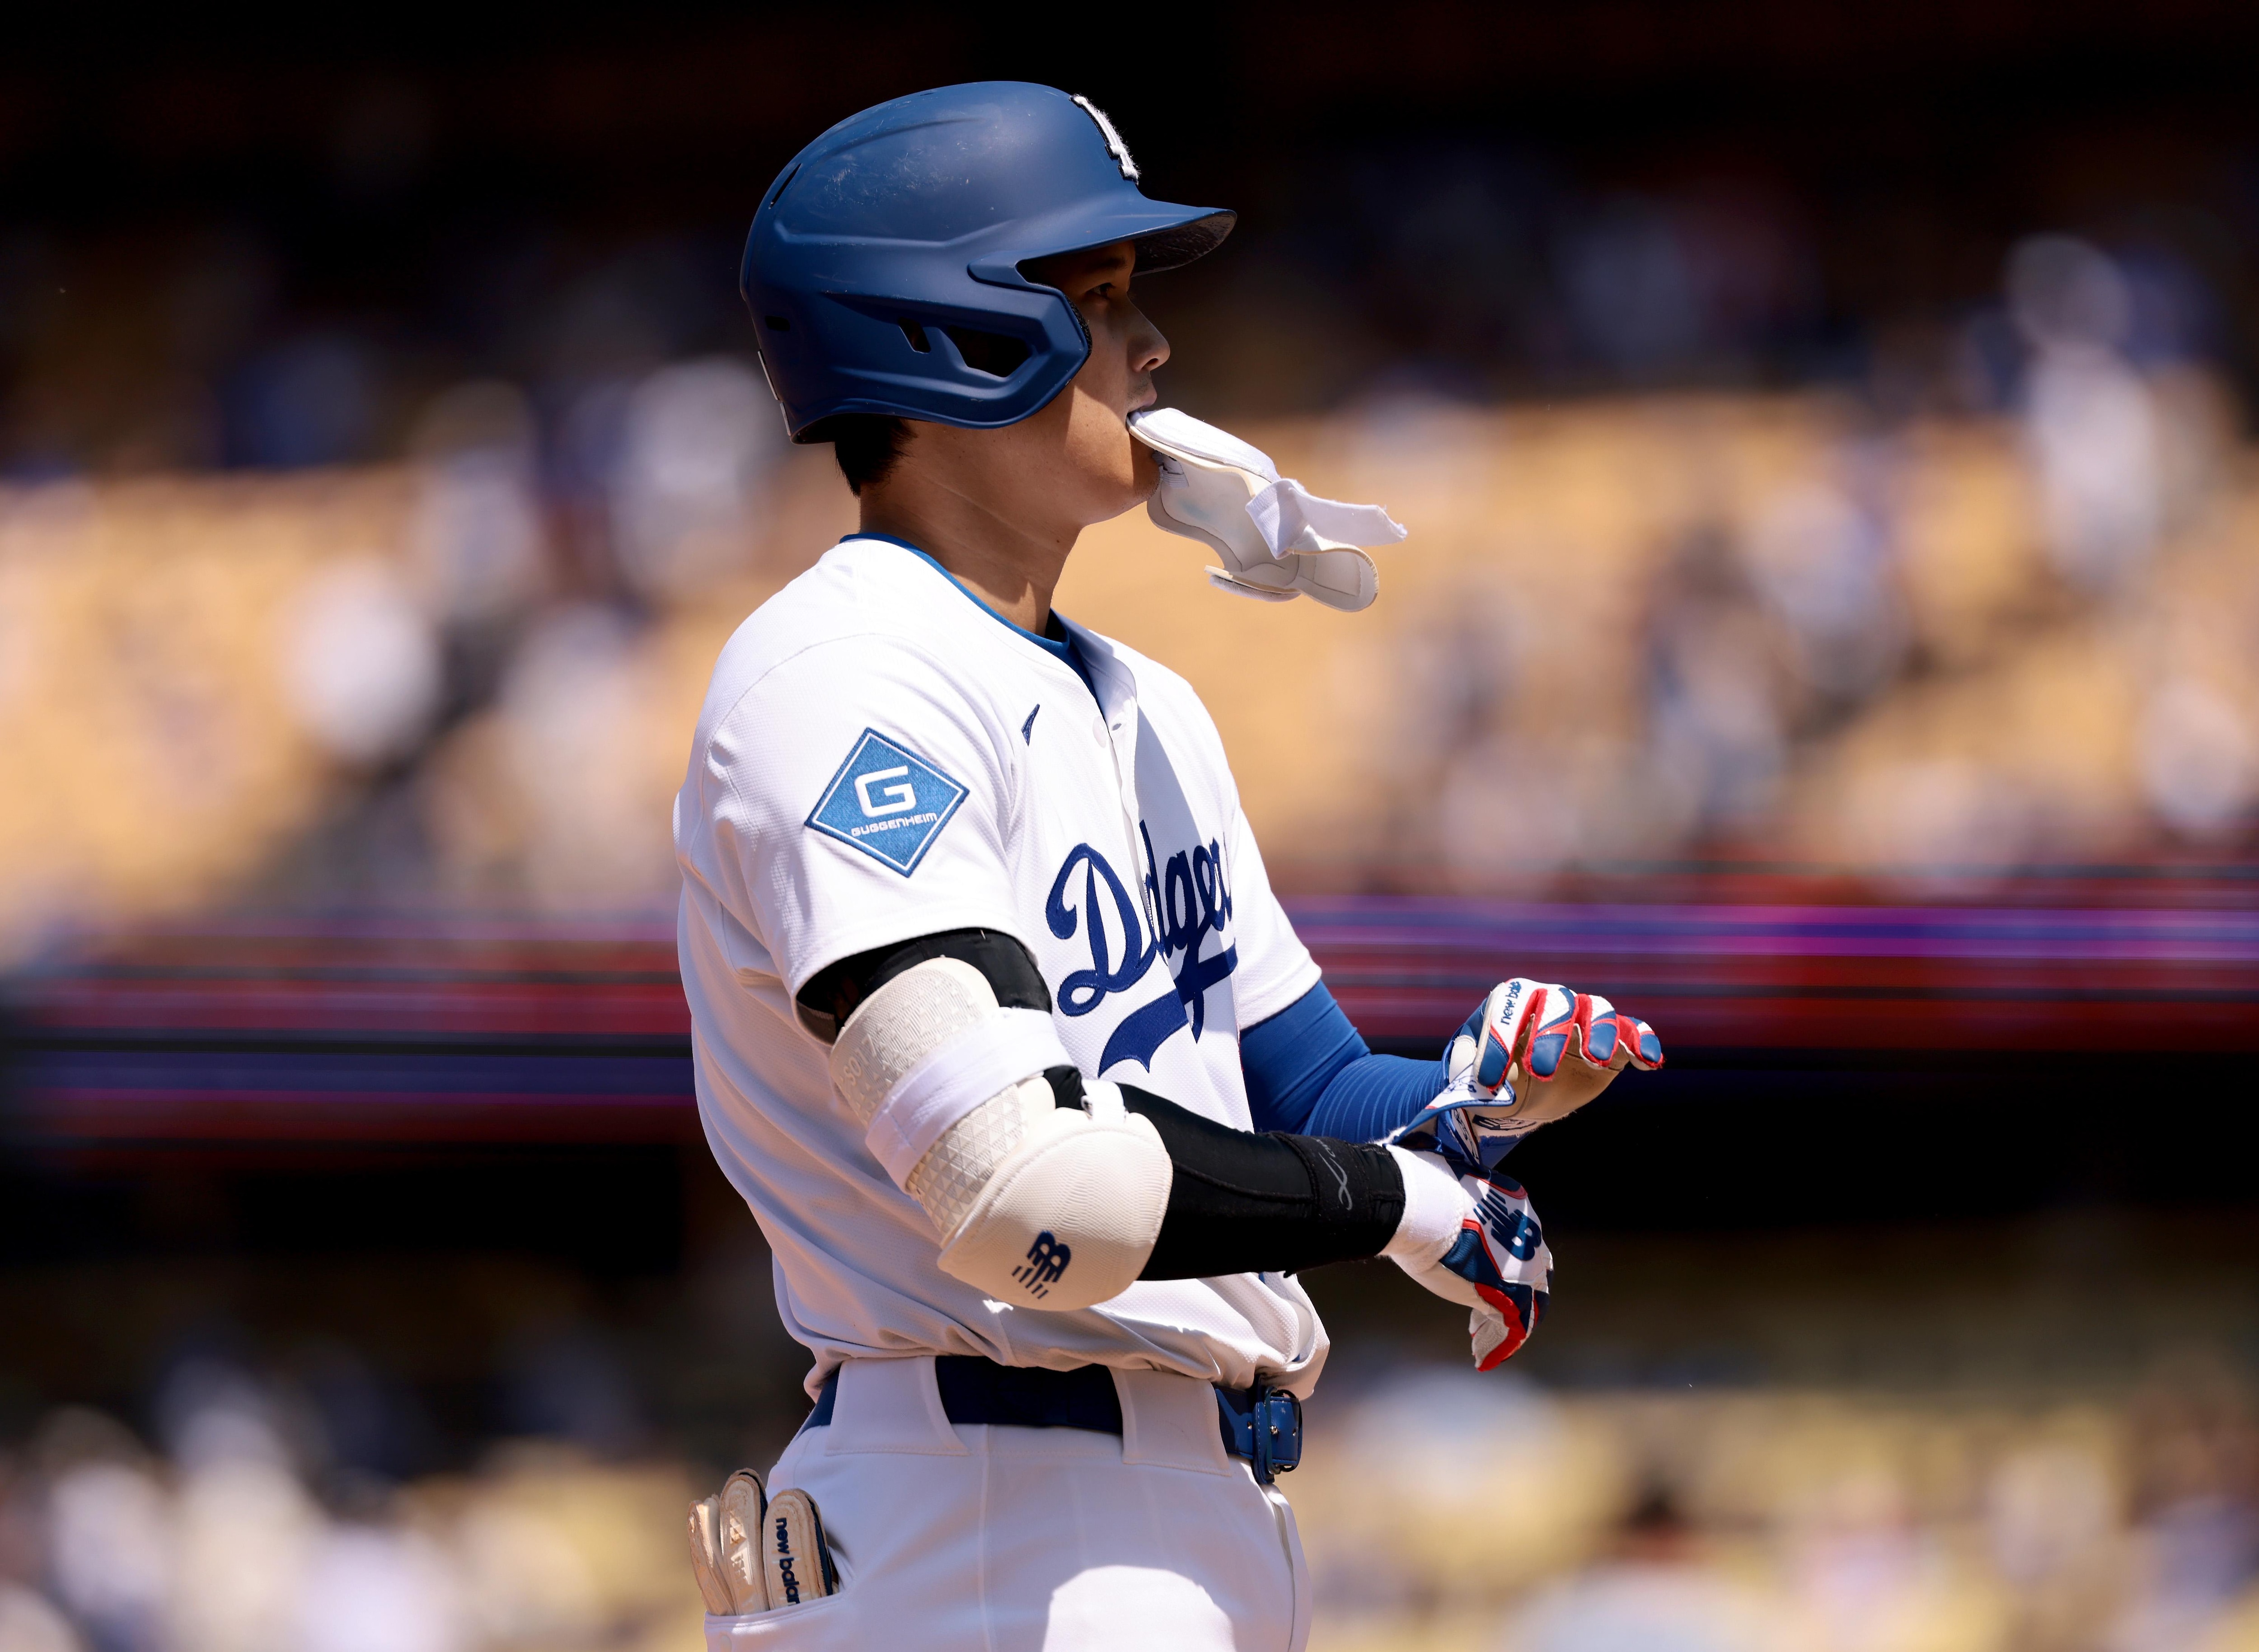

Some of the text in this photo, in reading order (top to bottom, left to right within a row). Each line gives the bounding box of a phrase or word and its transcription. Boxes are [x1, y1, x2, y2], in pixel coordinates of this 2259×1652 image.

[853, 765, 917, 818] G
[851, 812, 938, 837] GUGGENHEIM
[1500, 999, 1516, 1025] new
[775, 1517, 790, 1554] new
